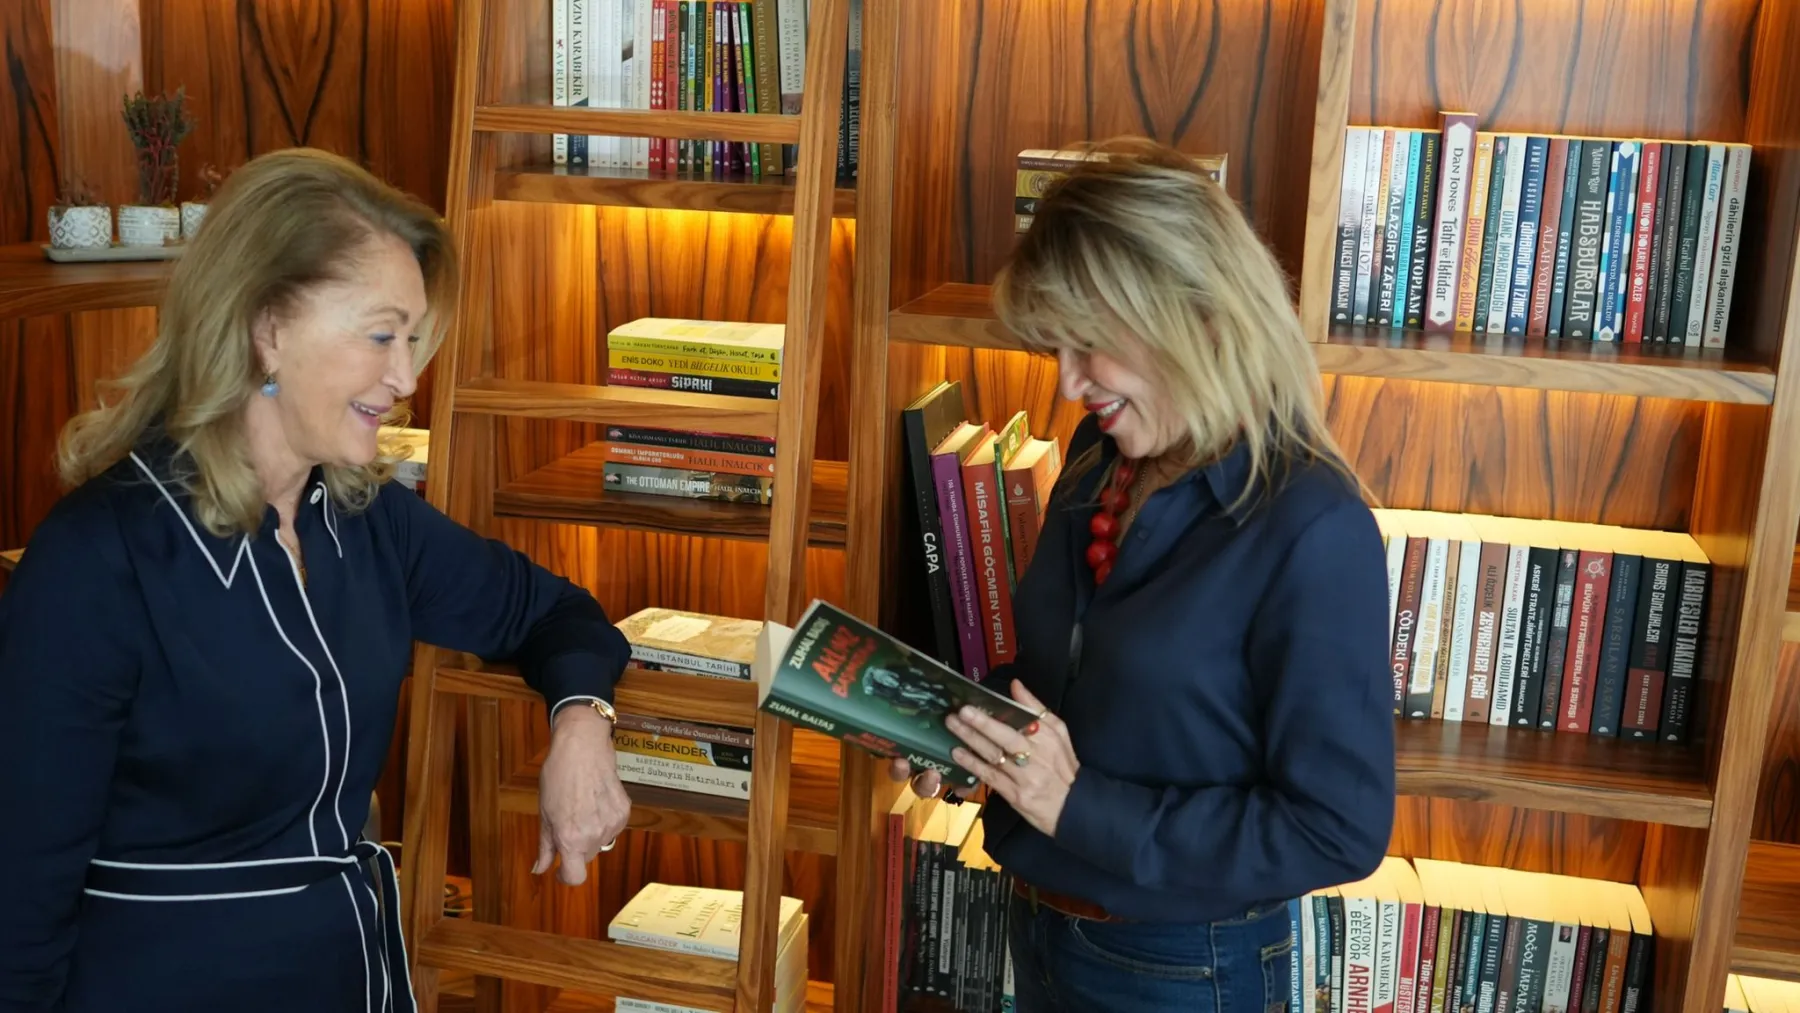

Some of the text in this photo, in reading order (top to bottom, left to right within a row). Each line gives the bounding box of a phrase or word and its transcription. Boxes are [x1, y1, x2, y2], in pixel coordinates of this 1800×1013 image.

[556, 53, 564, 100] AVRUPA
[573, 30, 584, 96] KARABEKİR
[1425, 138, 1434, 163] AHMET
[1385, 184, 1402, 261] MALAZGİRT
[1415, 225, 1428, 252] ARA
[1441, 217, 1459, 246] Taht
[1500, 210, 1514, 238] UTANÇ
[1611, 215, 1623, 258] MEDRESELER
[1358, 250, 1372, 276] 1071
[1540, 225, 1554, 265] ALLAH
[1554, 231, 1569, 294] GAZNELİLER
[1569, 200, 1602, 321] HABSBURGLAR
[1680, 237, 1695, 271] İstanbul
[1721, 245, 1732, 267] gizli
[1408, 256, 1425, 314] TOPLAM
[1436, 259, 1454, 301] İktidar
[1458, 218, 1482, 318] BUNU Herkes BİLİR
[1491, 242, 1512, 312] İMPARATORLUĞU
[1608, 282, 1616, 290] NE
[1380, 265, 1394, 311] ZAFERİ
[1604, 291, 1615, 322] DEĞİLDİ?
[1712, 268, 1729, 333] alışkanlıkları
[622, 356, 761, 376] ENİS DOKO YEDİ BİLGELİK OKULU
[671, 375, 713, 392] SİPAHİ
[688, 456, 719, 467] HALİL
[721, 458, 764, 471] İNALCIK
[626, 476, 638, 485] THE
[639, 476, 678, 490] OTTOMAN
[679, 480, 710, 493] EMPIRE
[948, 491, 958, 513] YILINDA
[923, 532, 939, 574] CAPA
[974, 481, 1007, 654] MİSAFİR GÖÇMEN YERLİ
[1581, 583, 1593, 613] BÜYÜK
[1395, 610, 1416, 660] ÇÖLDEKİ
[1470, 565, 1498, 699] ALİ ÖZÇELİK ZEYBEKLER ÇAĞI
[1503, 607, 1518, 640] SULTAN
[1606, 607, 1625, 673] SARSILAN
[1672, 569, 1706, 679] KARDEŞLER TAKIMI
[657, 652, 736, 673] İSTANBUL TARİHİ
[789, 637, 815, 670] ZUHAL
[1520, 637, 1533, 678] TEMELLERİ
[769, 701, 800, 718] ZUHAL
[1600, 678, 1614, 721] SARAY
[643, 738, 708, 758] İSKENDER
[907, 753, 952, 775] NUDGE
[1350, 911, 1362, 960] BEEVOR
[1362, 914, 1371, 957] ANTONY
[1522, 922, 1538, 966] MOĞOL
[1378, 941, 1391, 1000] KARABEKİR
[1608, 964, 1620, 988] Living
[1432, 986, 1444, 1000] IV.
[1606, 999, 1615, 1010] the
[1607, 990, 1616, 999] in
